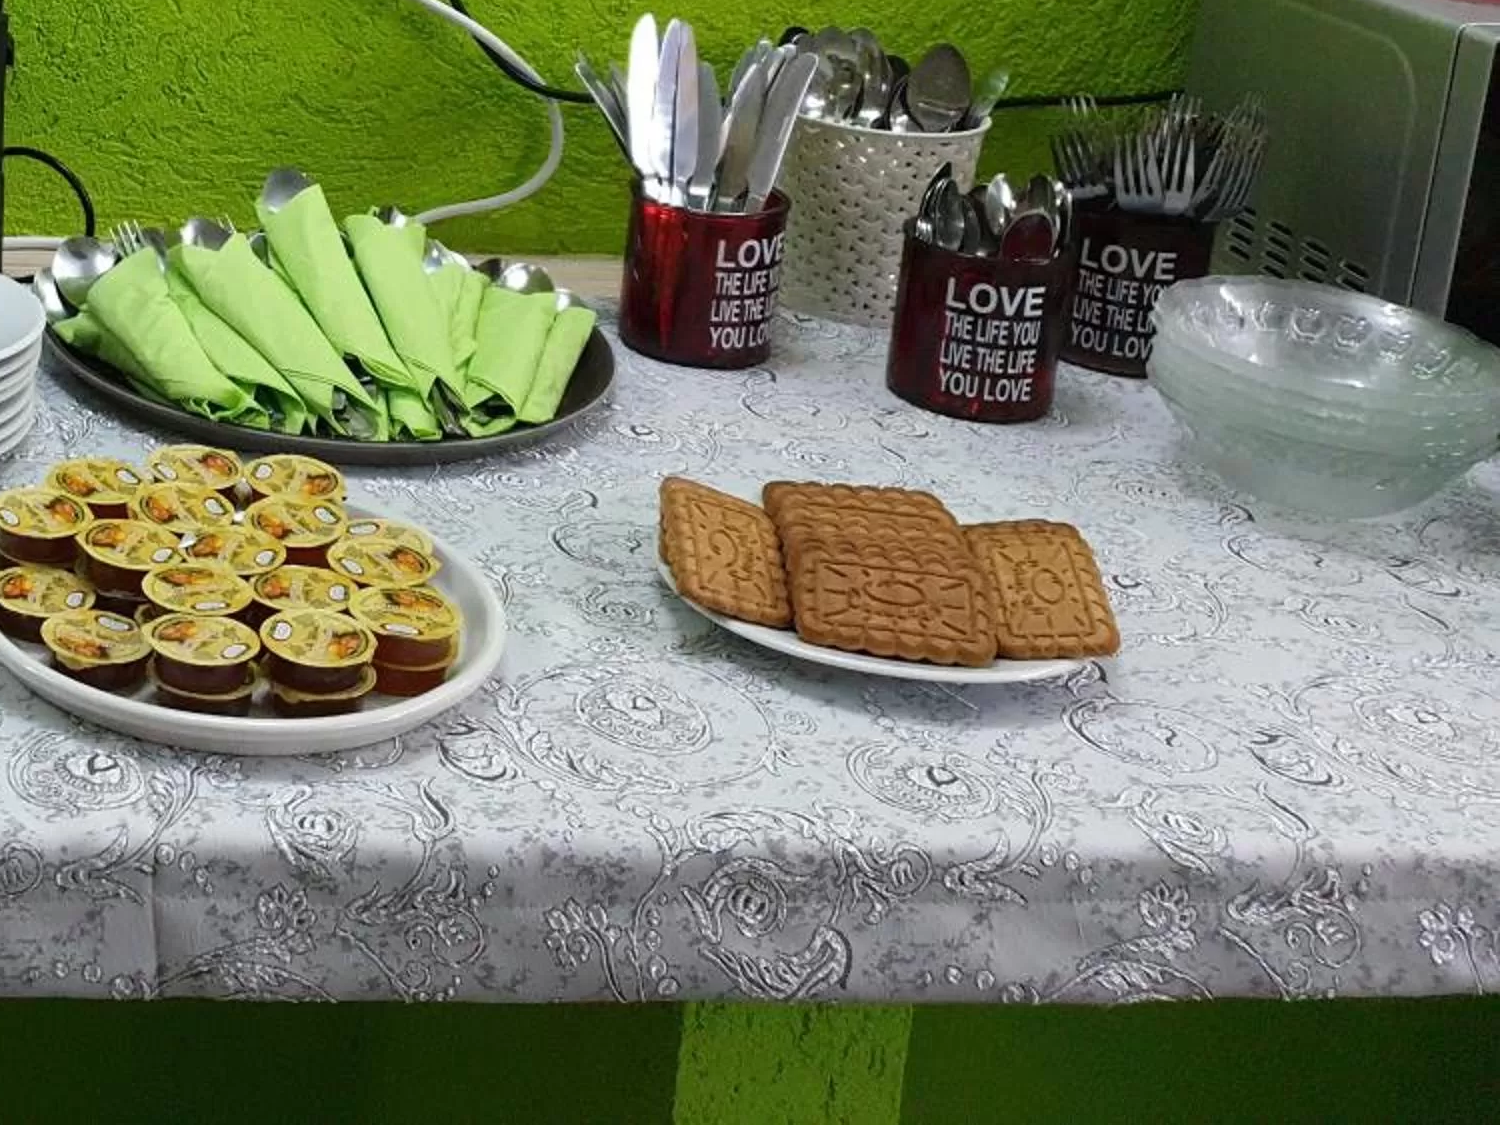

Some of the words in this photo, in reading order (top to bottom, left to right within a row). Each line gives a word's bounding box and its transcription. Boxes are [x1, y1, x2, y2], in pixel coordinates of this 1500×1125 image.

[1080, 237, 1177, 280] LOVE
[715, 272, 741, 295] THE
[743, 271, 767, 295] LIFE
[945, 277, 1046, 317] LOVE
[1078, 268, 1105, 298] THE
[1106, 277, 1140, 304] LIFE
[1143, 283, 1165, 306] YO
[710, 299, 740, 323] LIVE
[743, 297, 765, 322] THE
[945, 310, 975, 340] THE
[976, 318, 1010, 346] LIFE
[1013, 321, 1041, 346] YOU
[1073, 295, 1103, 325] LIVE
[1106, 304, 1136, 332] THE
[1137, 310, 1154, 334] LI
[709, 326, 746, 349] YOU
[1071, 319, 1109, 352] YOU
[1112, 334, 1153, 360] LOV
[940, 338, 973, 369] LIVE
[976, 347, 1006, 373] THE
[1007, 350, 1037, 374] LIFE
[939, 366, 979, 398] YOU
[983, 378, 1033, 402] LOVE
